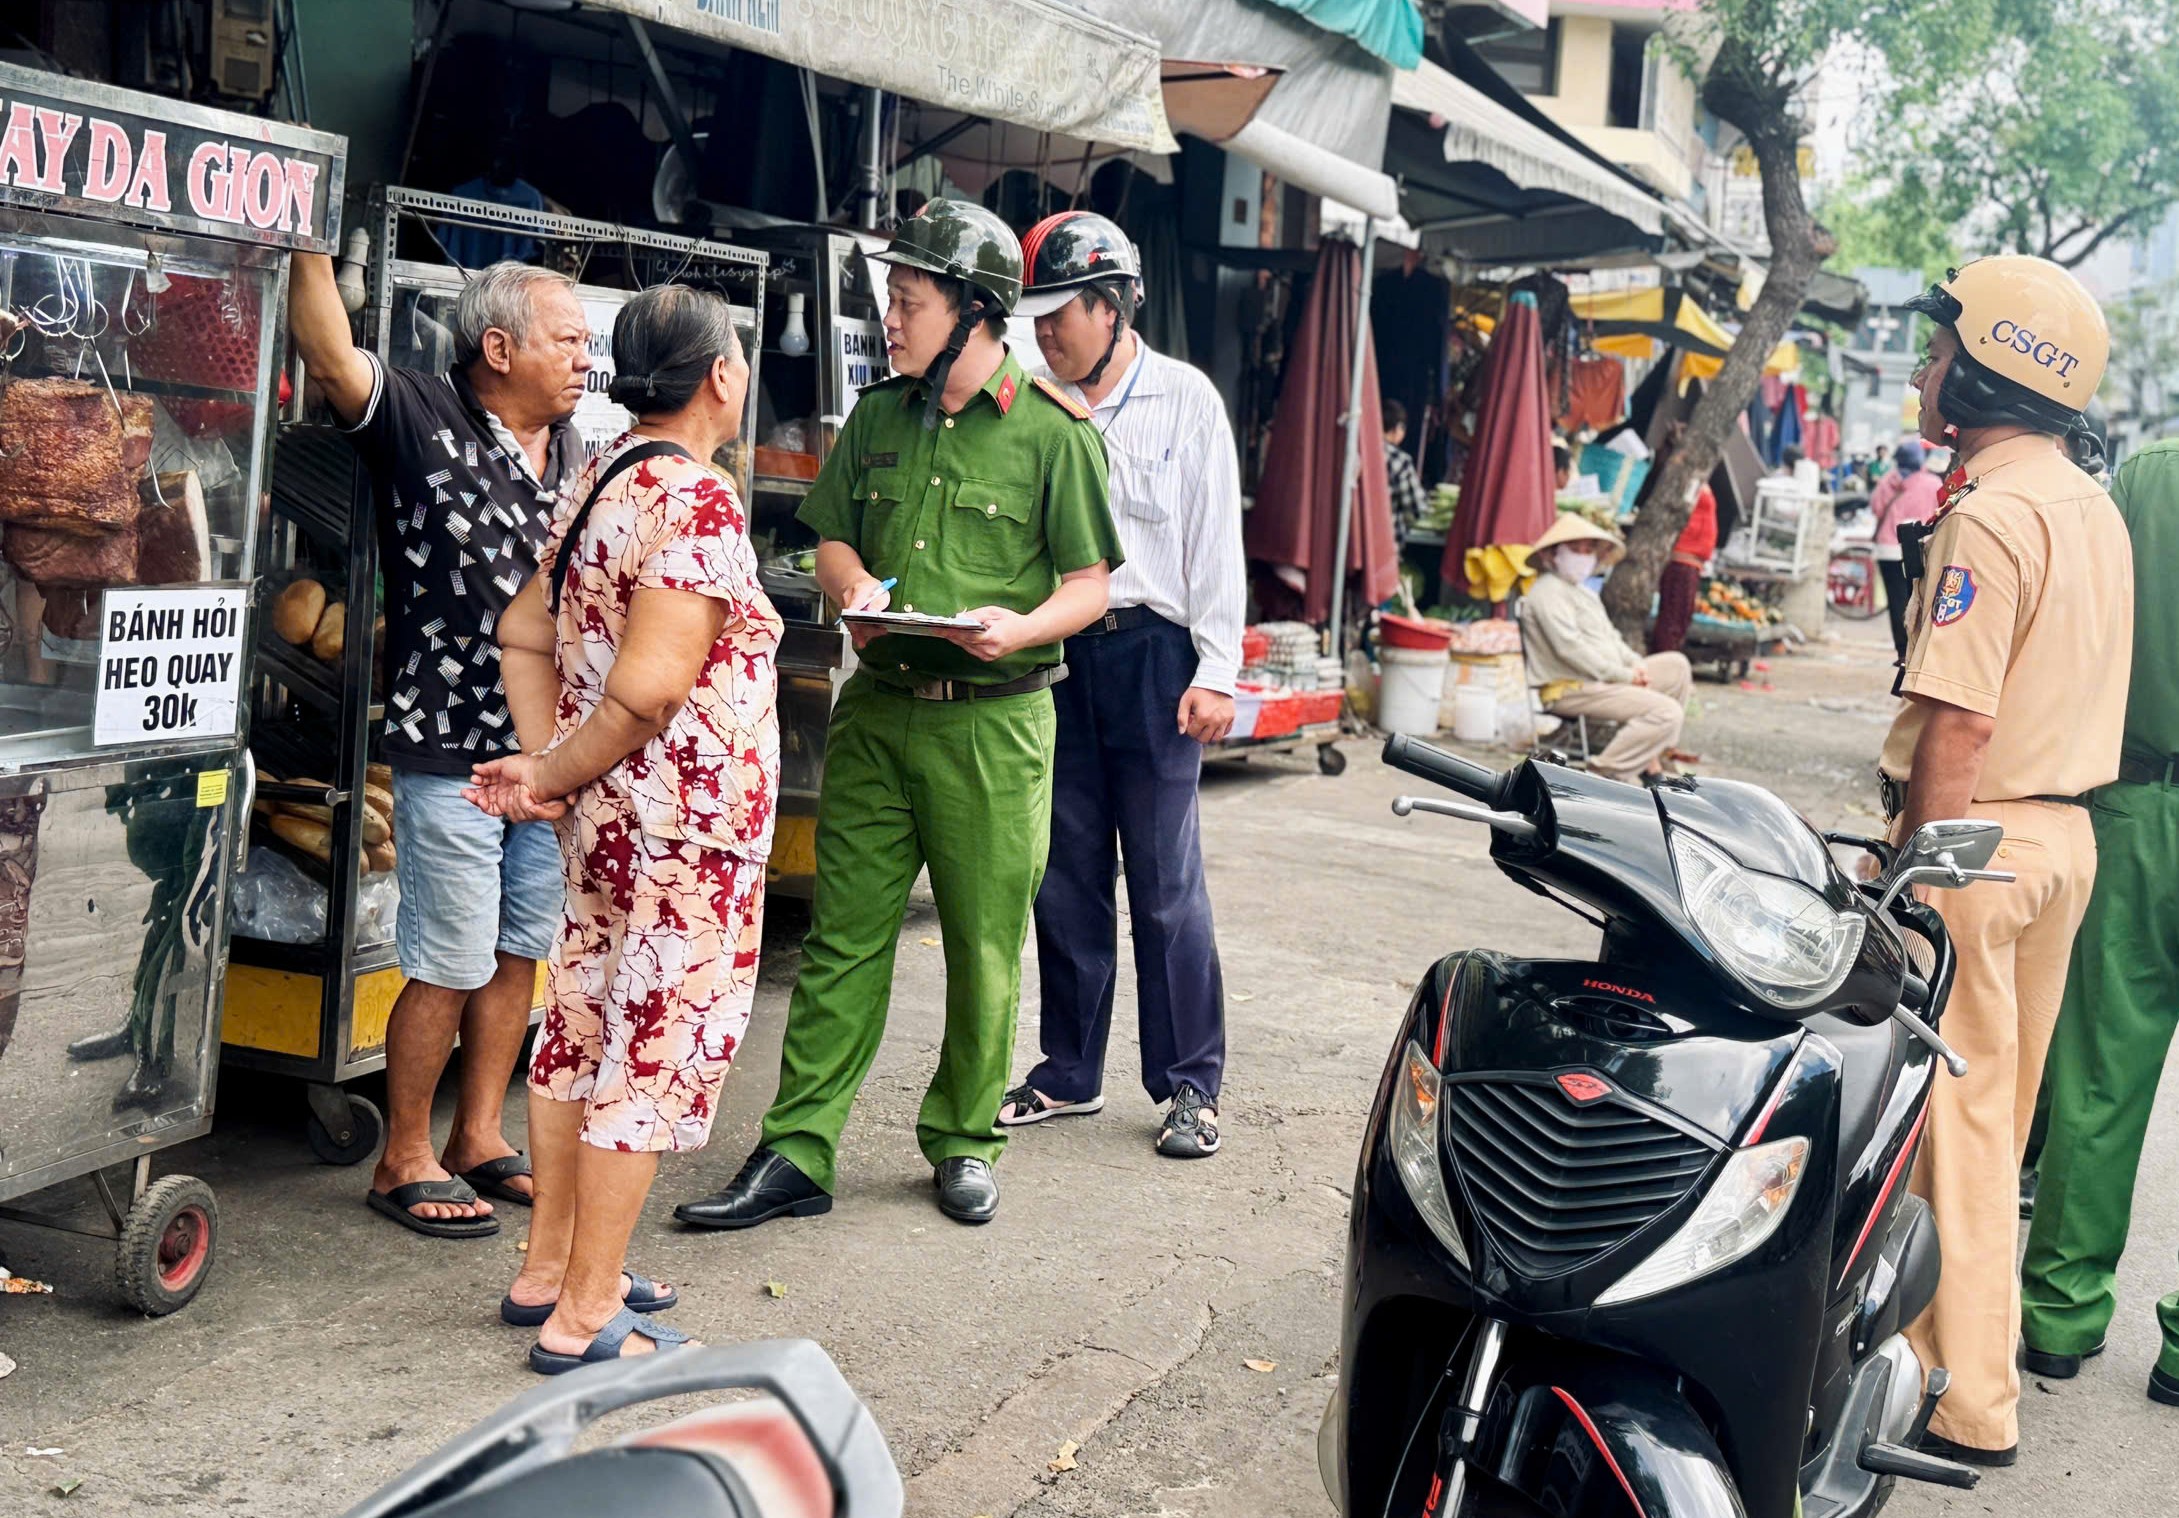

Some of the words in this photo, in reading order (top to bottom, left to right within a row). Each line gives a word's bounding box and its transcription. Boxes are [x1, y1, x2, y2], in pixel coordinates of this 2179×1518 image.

[937, 64, 971, 96] The
[0, 97, 83, 195] AY
[82, 116, 172, 213] DA
[1991, 320, 2080, 378] CSGT
[109, 603, 184, 642] BÁNH
[192, 597, 237, 639] HỎI
[104, 656, 158, 690] HEO
[167, 652, 234, 689] QUAY
[1583, 978, 1657, 1005] HONDA
